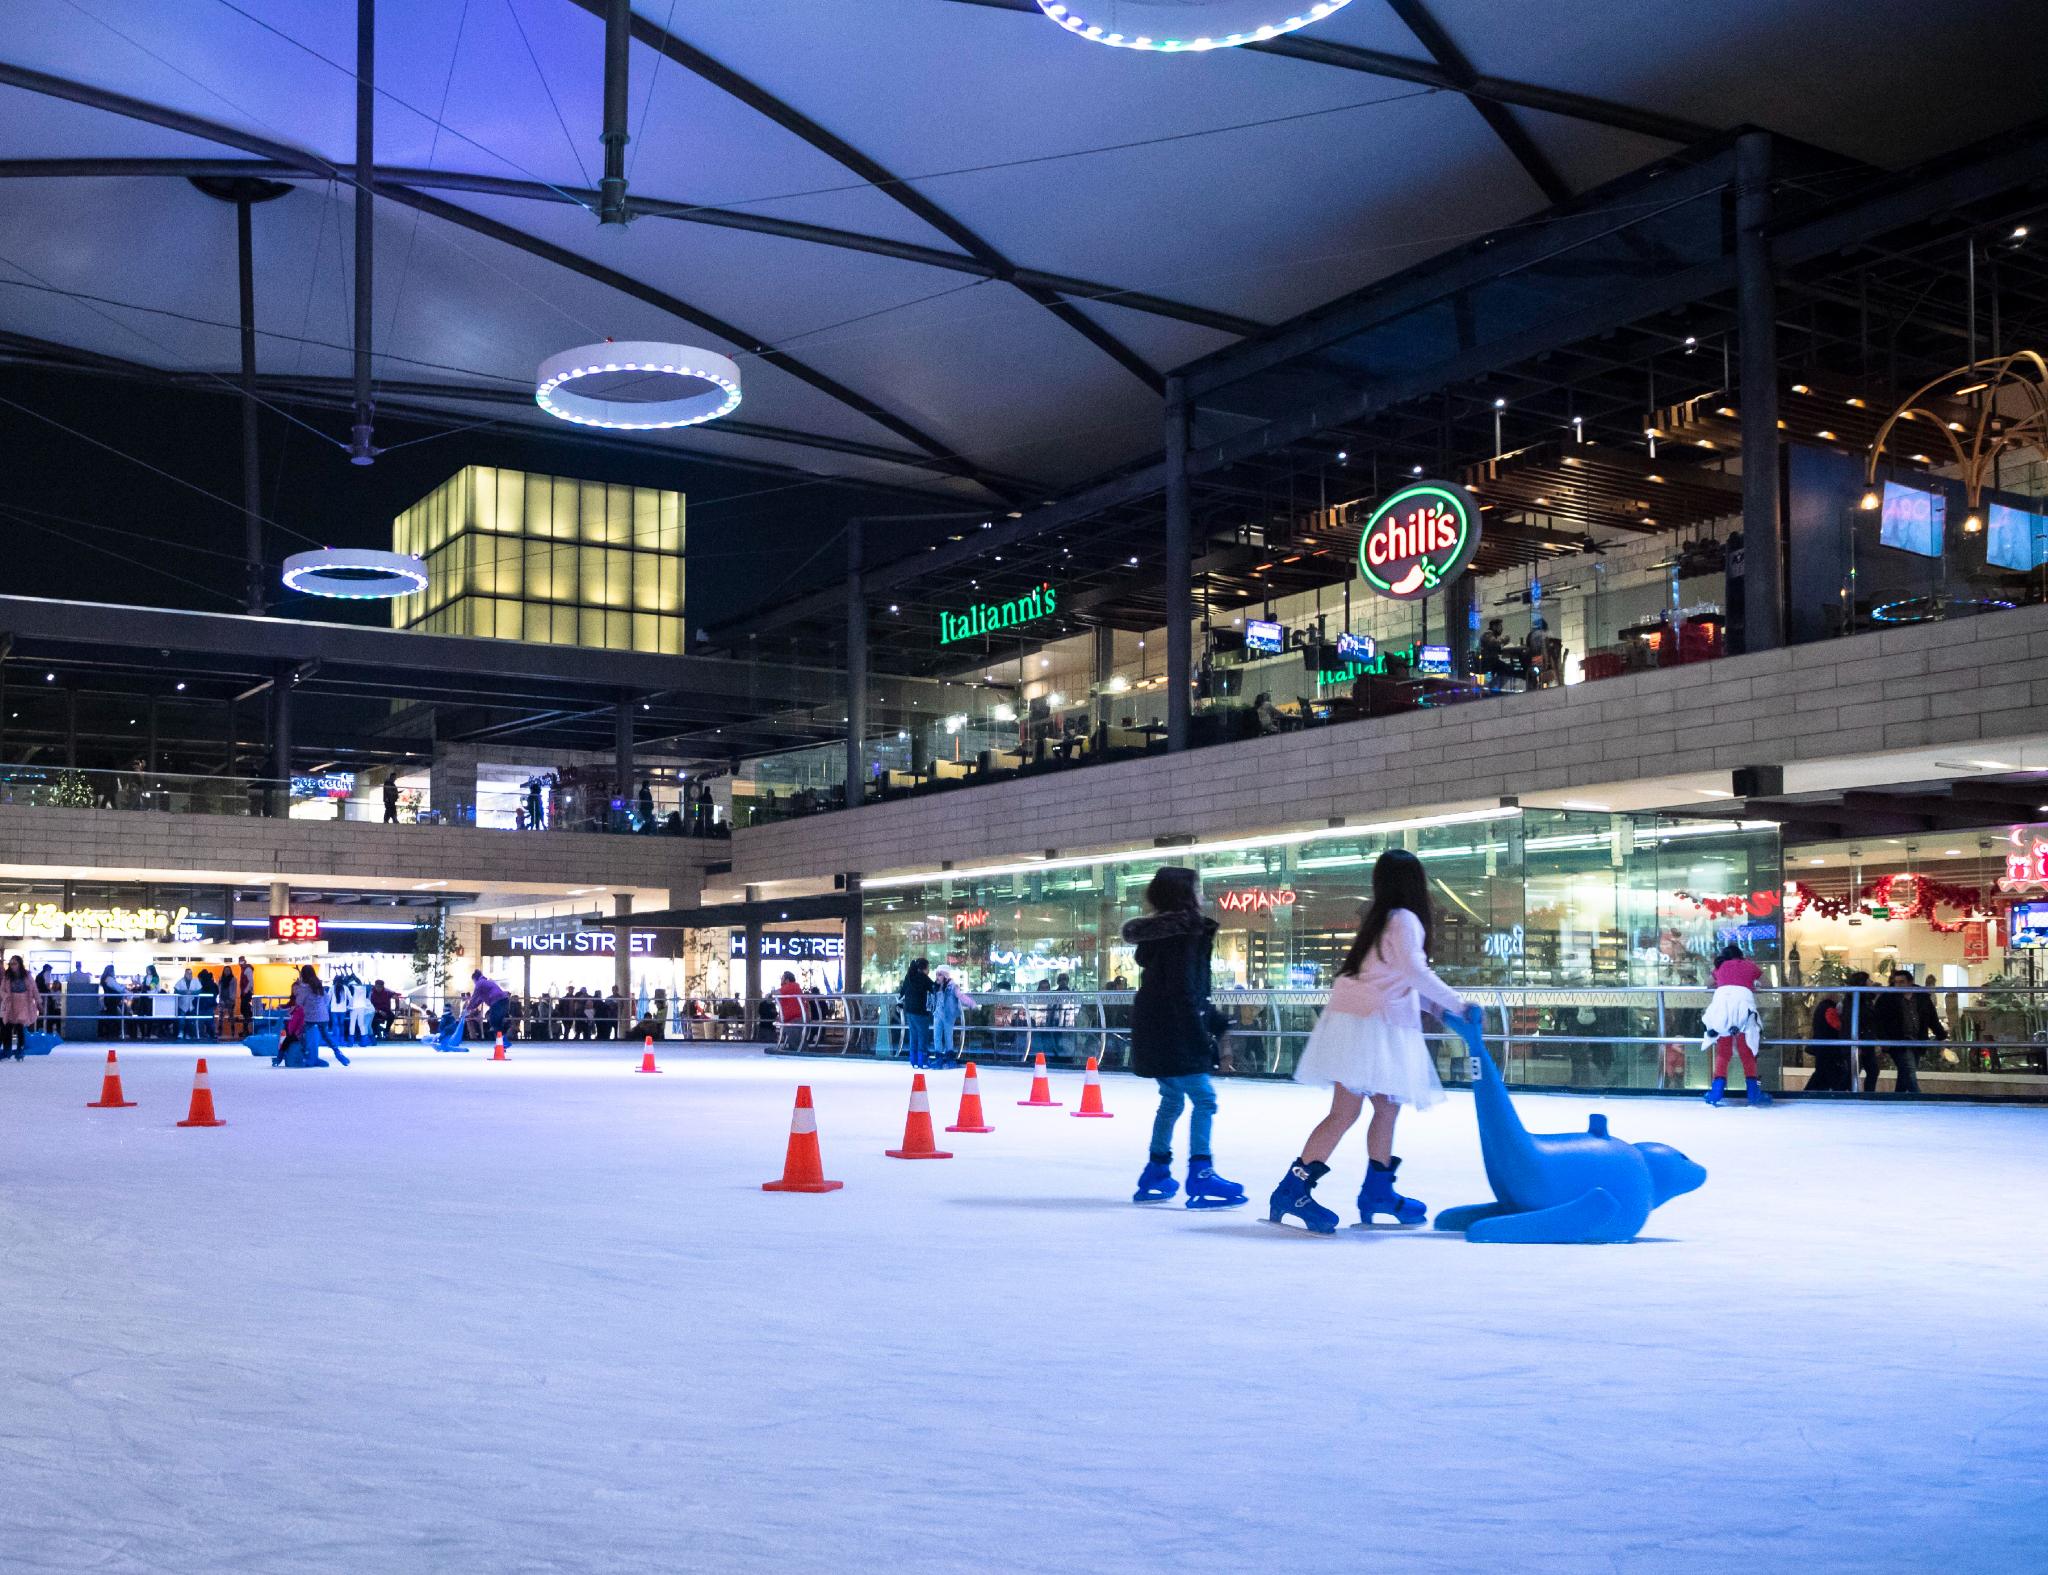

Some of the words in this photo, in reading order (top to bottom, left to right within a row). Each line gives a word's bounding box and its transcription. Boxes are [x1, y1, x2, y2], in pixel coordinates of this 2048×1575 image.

[940, 582, 1056, 645] Italianni's
[291, 776, 317, 790] OOD
[1218, 888, 1297, 913] VAPIANO
[279, 918, 317, 937] 19:39
[511, 932, 565, 951] HIGH
[574, 932, 657, 952] STRET
[731, 936, 780, 955] HH
